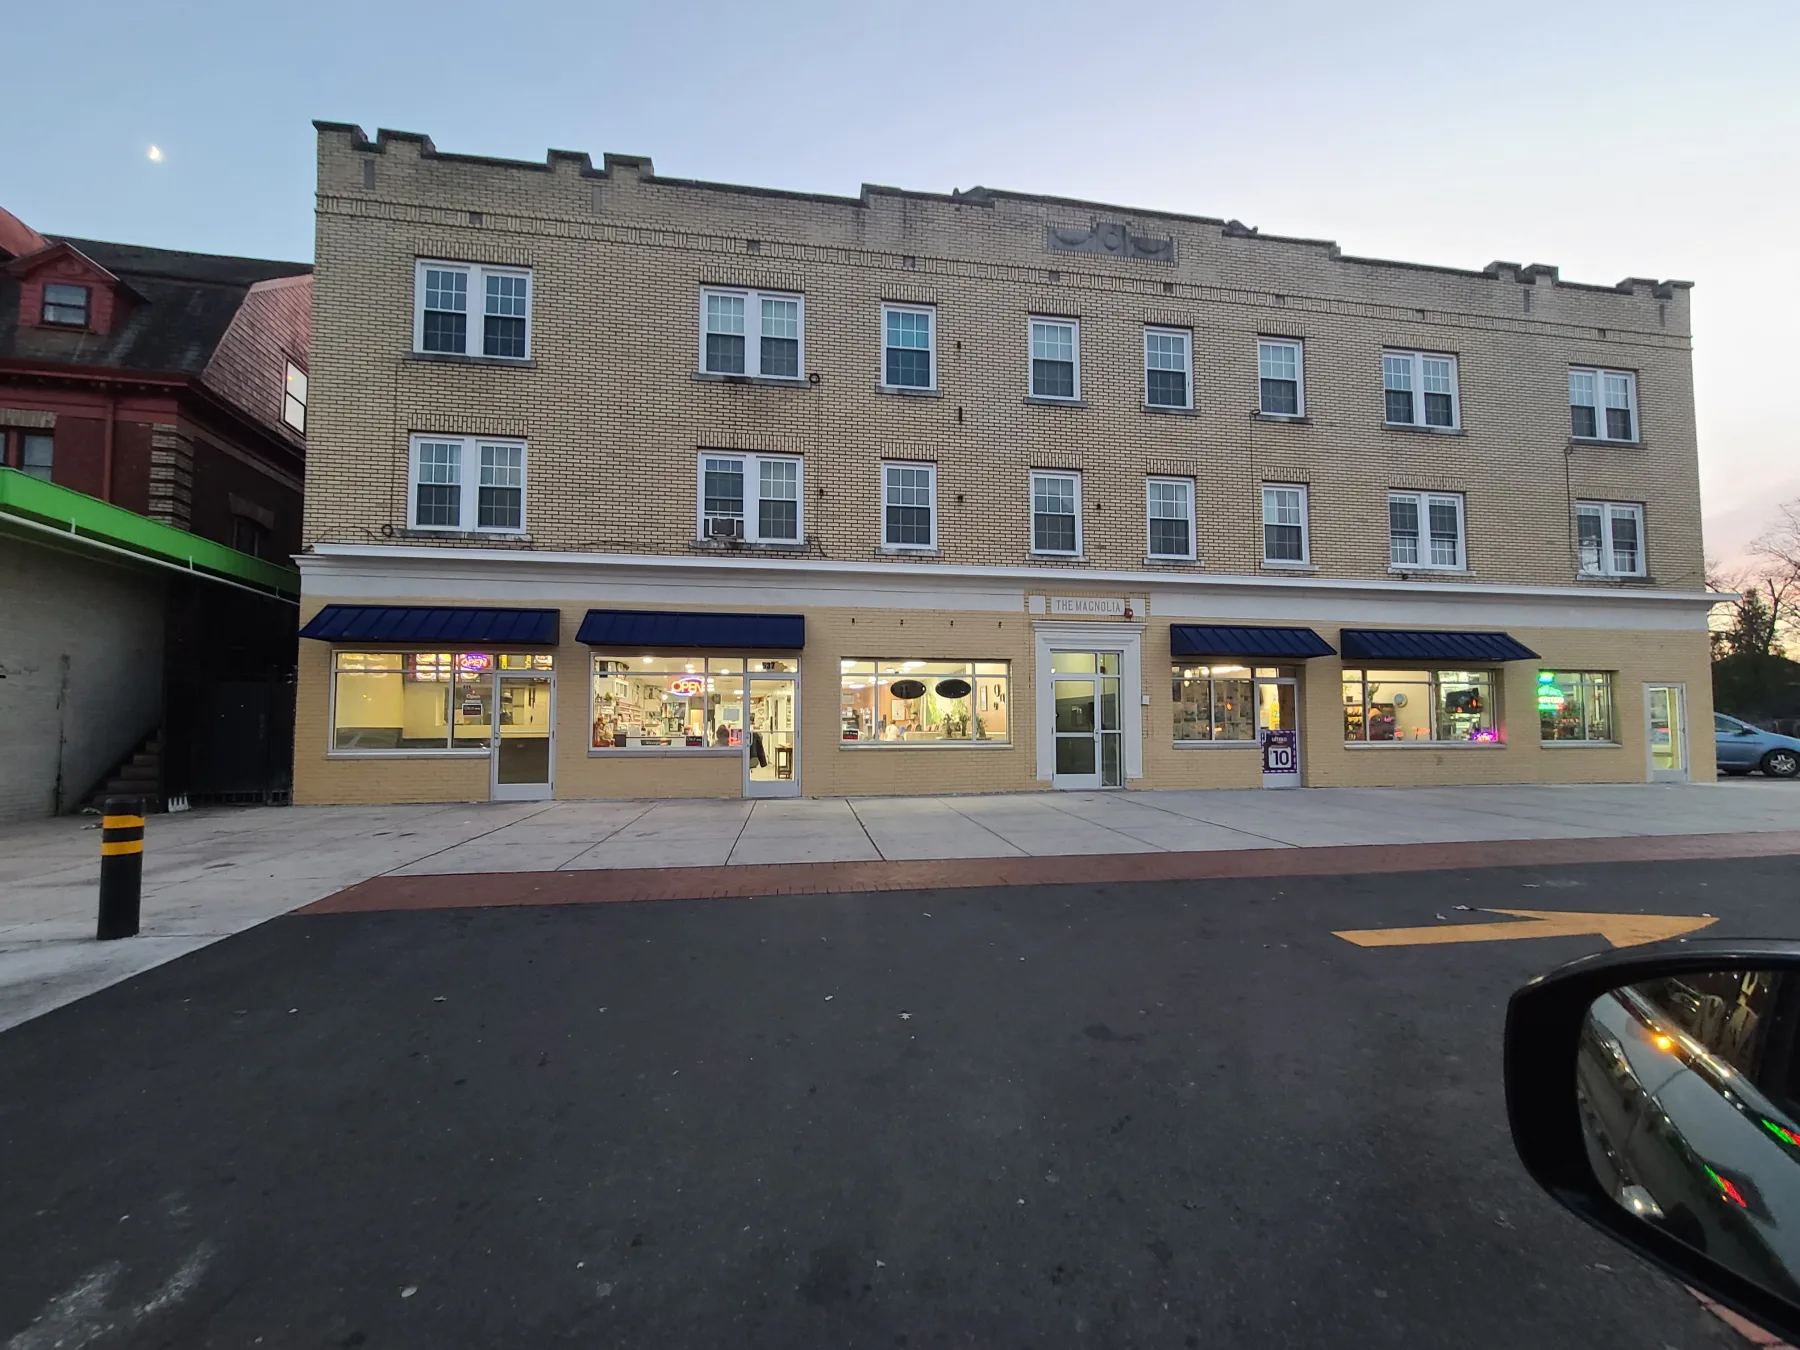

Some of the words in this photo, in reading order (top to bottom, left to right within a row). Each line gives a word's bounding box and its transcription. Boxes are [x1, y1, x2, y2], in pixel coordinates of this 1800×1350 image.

[1057, 600, 1074, 611] THE
[1075, 600, 1121, 612] MAGNOLIA
[460, 659, 488, 667] OPEN
[671, 680, 704, 693] OPEN
